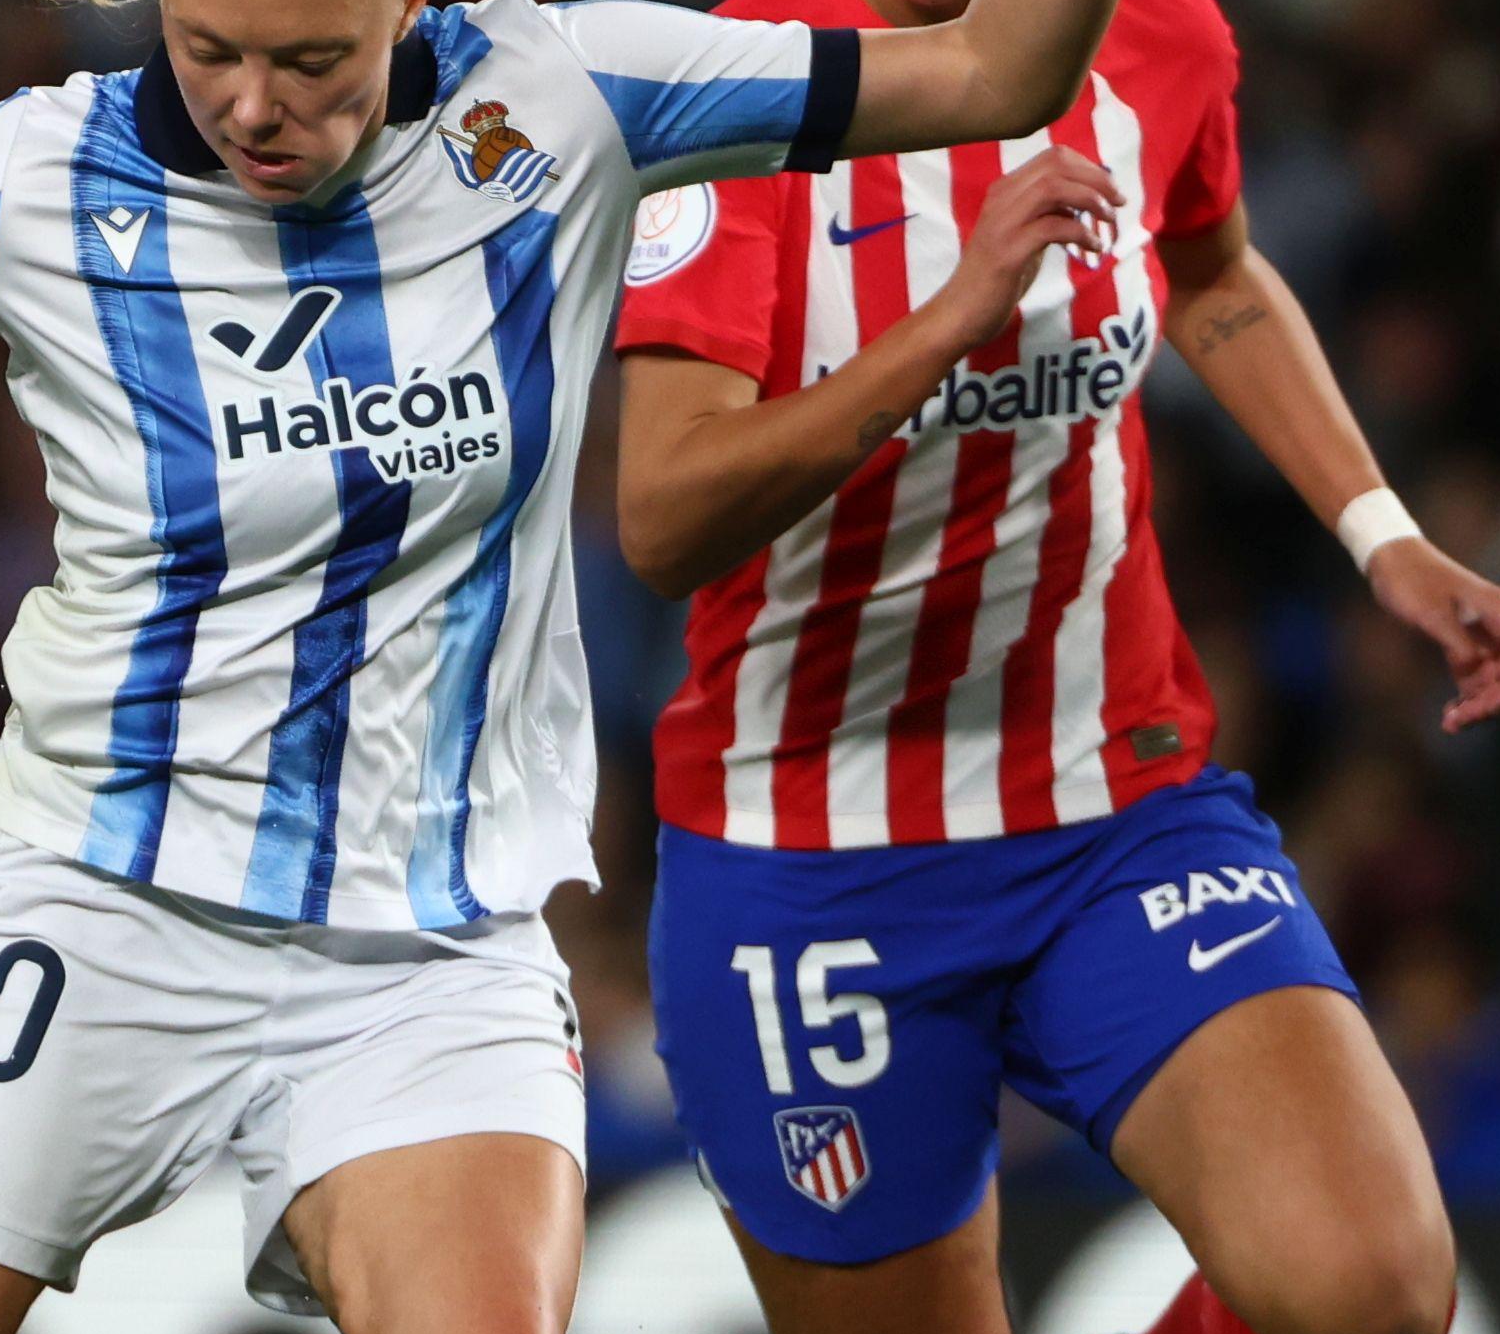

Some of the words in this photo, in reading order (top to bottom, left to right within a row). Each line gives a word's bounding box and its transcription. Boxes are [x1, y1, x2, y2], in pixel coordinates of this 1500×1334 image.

[222, 367, 495, 459] Halcón
[817, 347, 1125, 432] rbalife
[376, 430, 500, 478] viajes
[1138, 864, 1298, 933] BAXI
[729, 937, 893, 1096] 15
